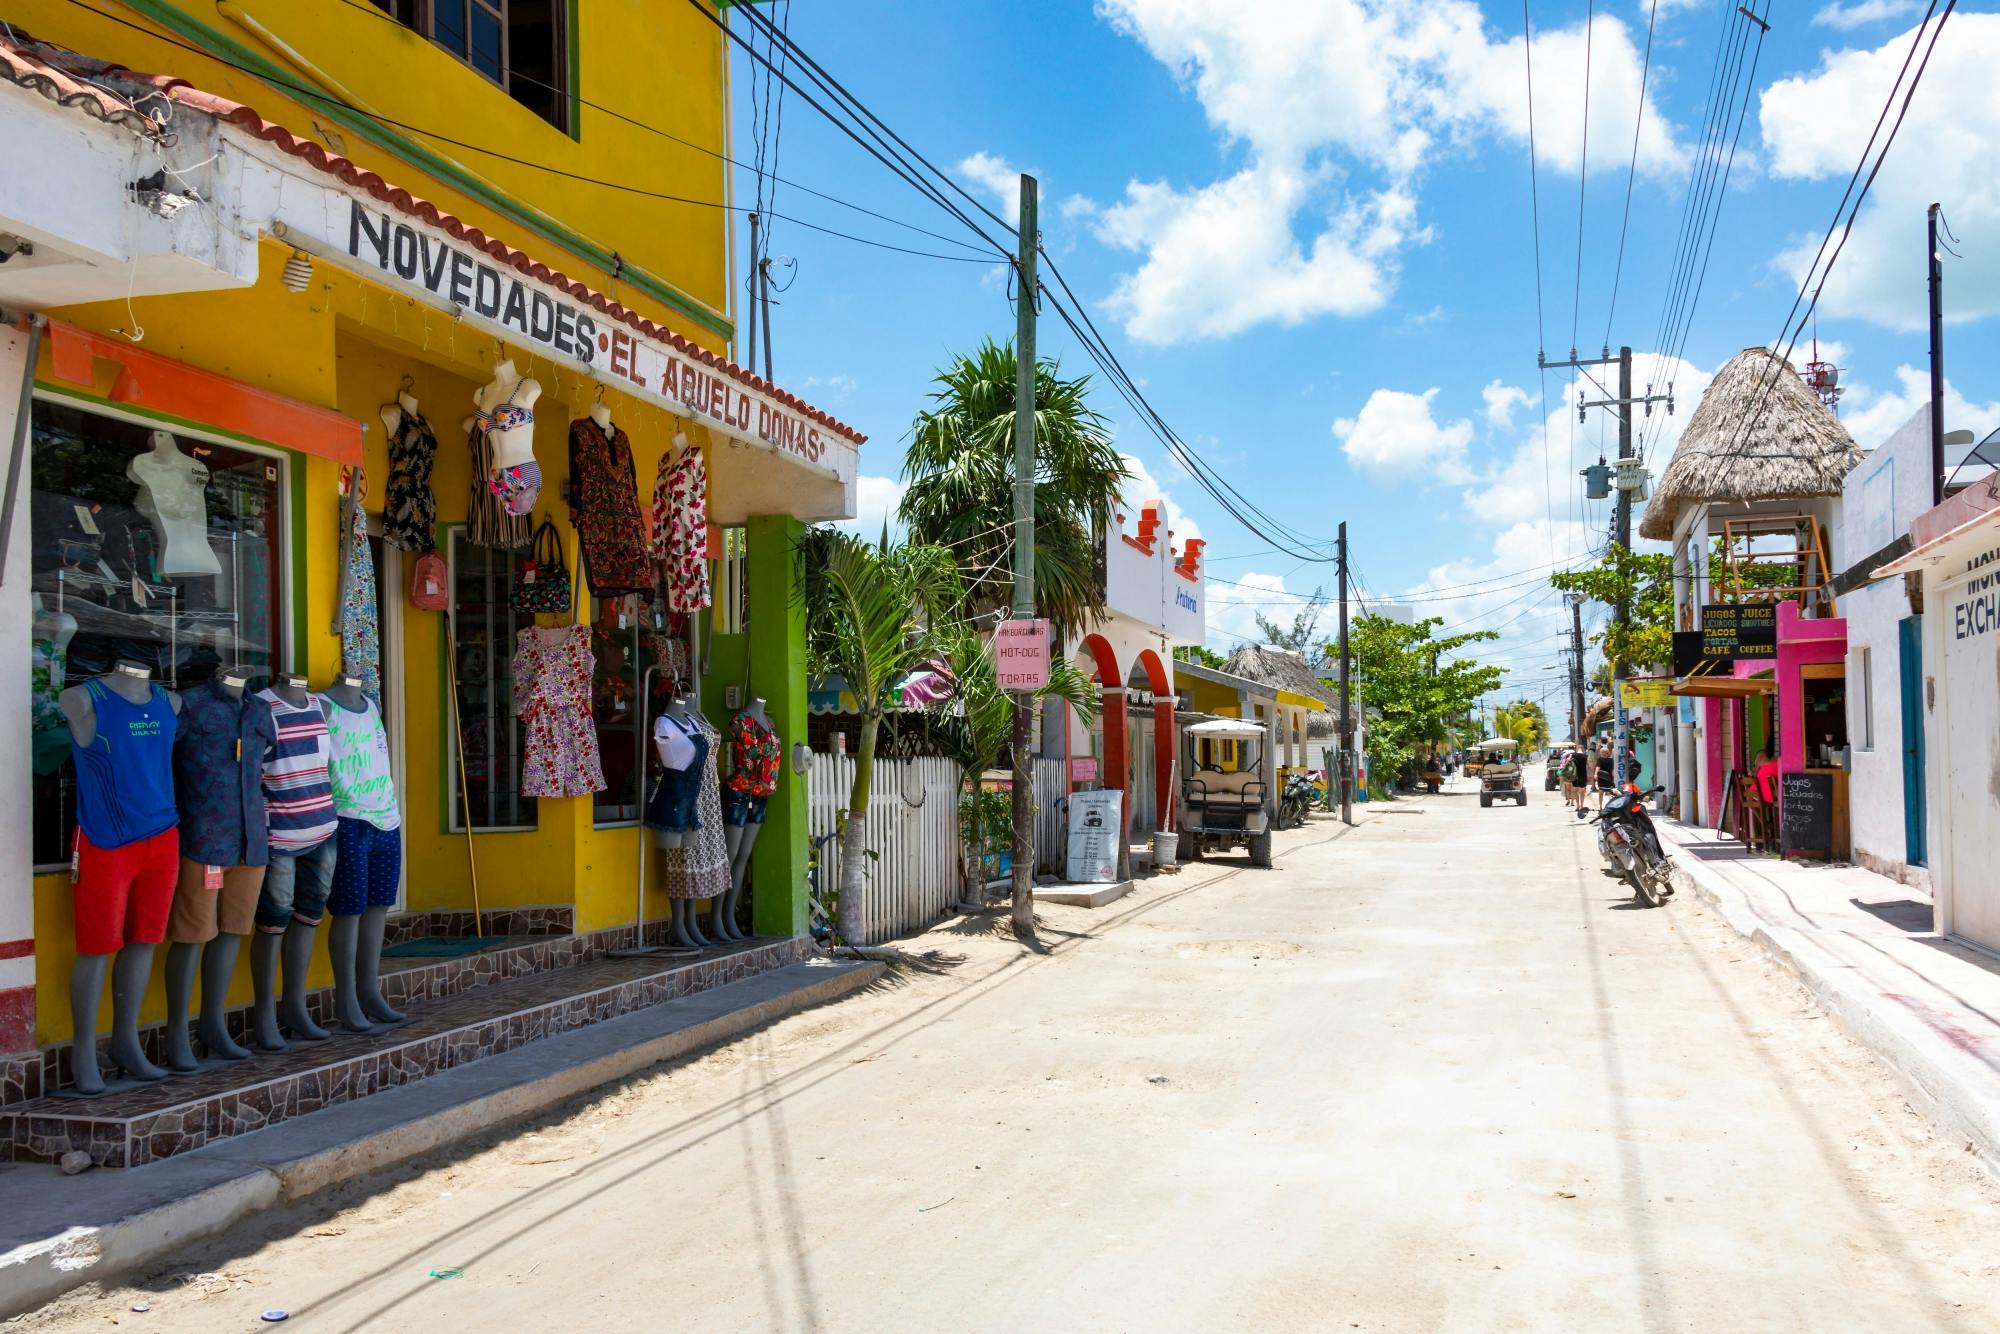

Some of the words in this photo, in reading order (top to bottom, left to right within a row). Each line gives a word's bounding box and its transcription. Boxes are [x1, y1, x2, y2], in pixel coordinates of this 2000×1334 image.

[350, 199, 596, 363] NOVEDADES
[610, 329, 646, 387] EL
[661, 356, 750, 431] ABUELO
[758, 400, 819, 463] DONAS
[1703, 609, 1736, 619] JUGOS
[1741, 608, 1772, 618] JUICE
[1704, 628, 1737, 637] TACOS
[1703, 637, 1738, 646] TORTAS
[1739, 644, 1774, 654] COFFEE
[999, 673, 1040, 685] TORTAS
[1782, 774, 1812, 792] Jugos
